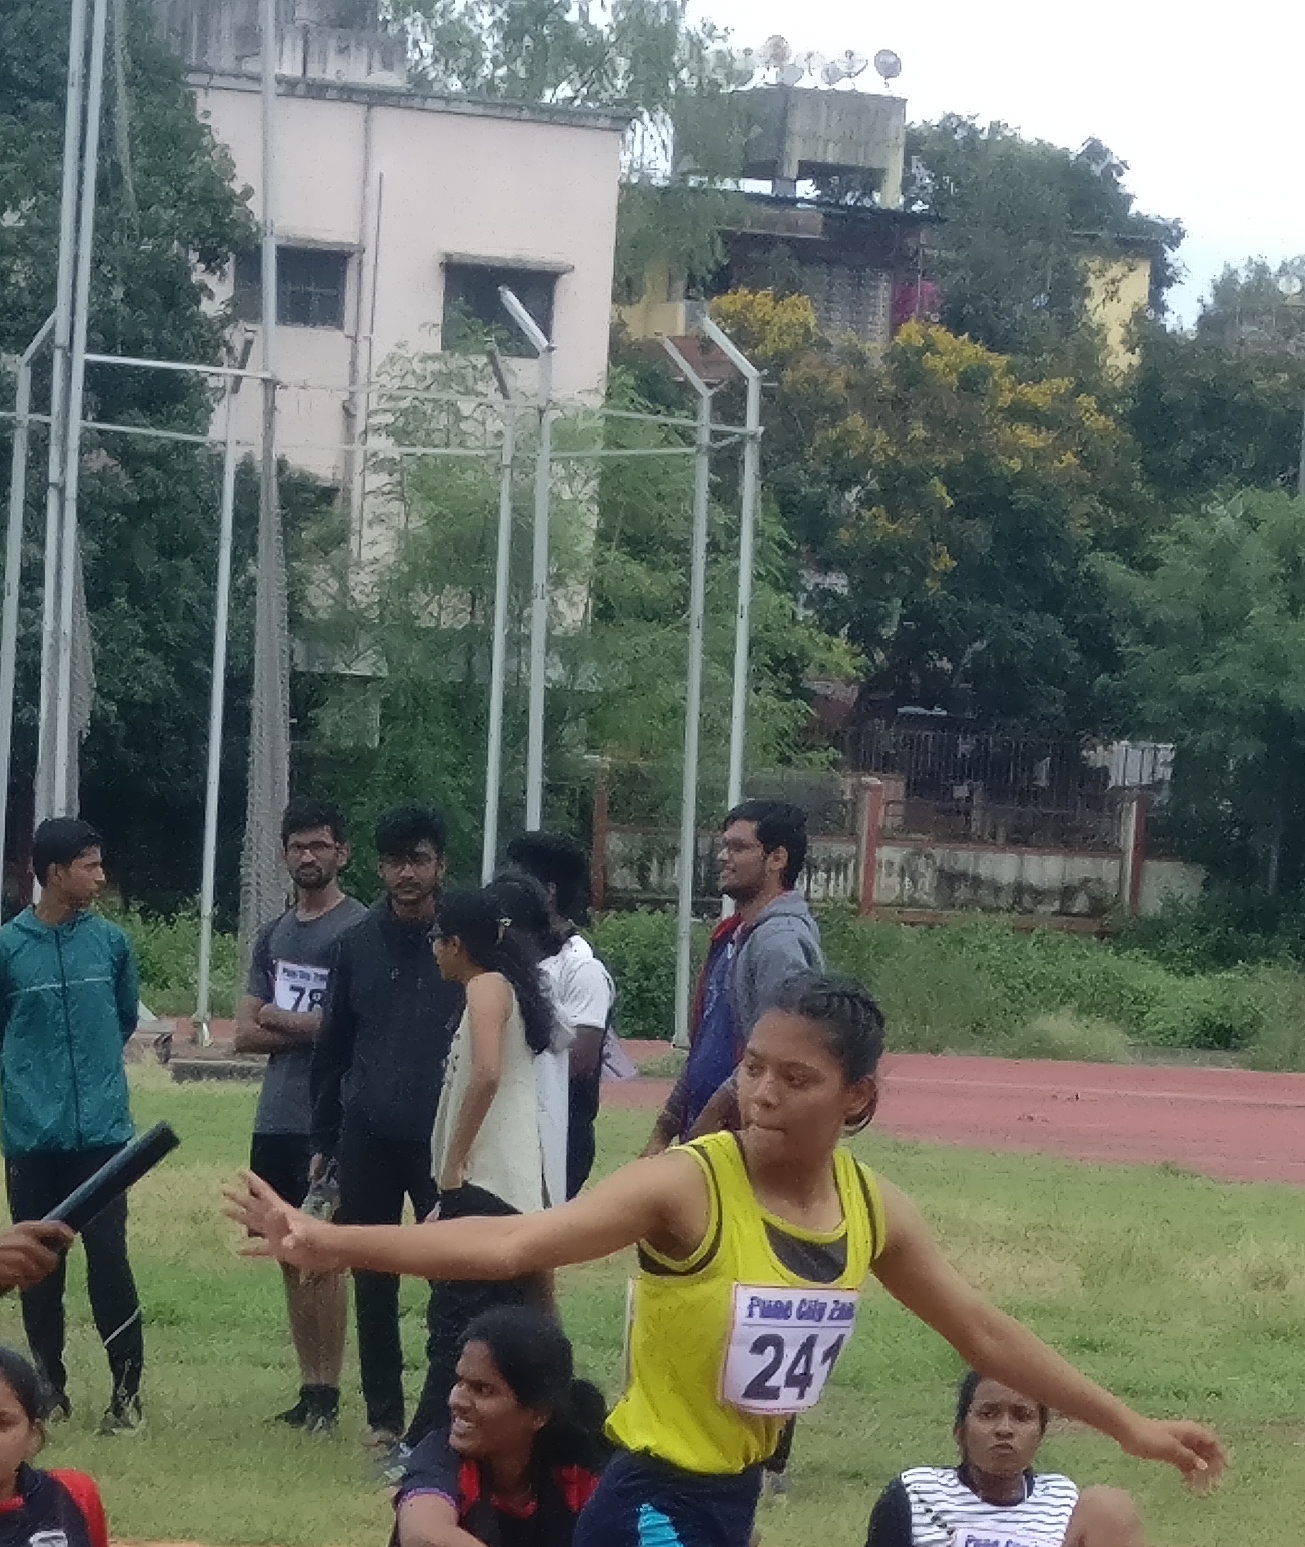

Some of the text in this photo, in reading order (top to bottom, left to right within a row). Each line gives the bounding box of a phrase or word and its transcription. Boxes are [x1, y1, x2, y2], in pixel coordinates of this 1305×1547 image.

[745, 1295, 855, 1323] Pune City Zon
[740, 1333, 846, 1401] 241
